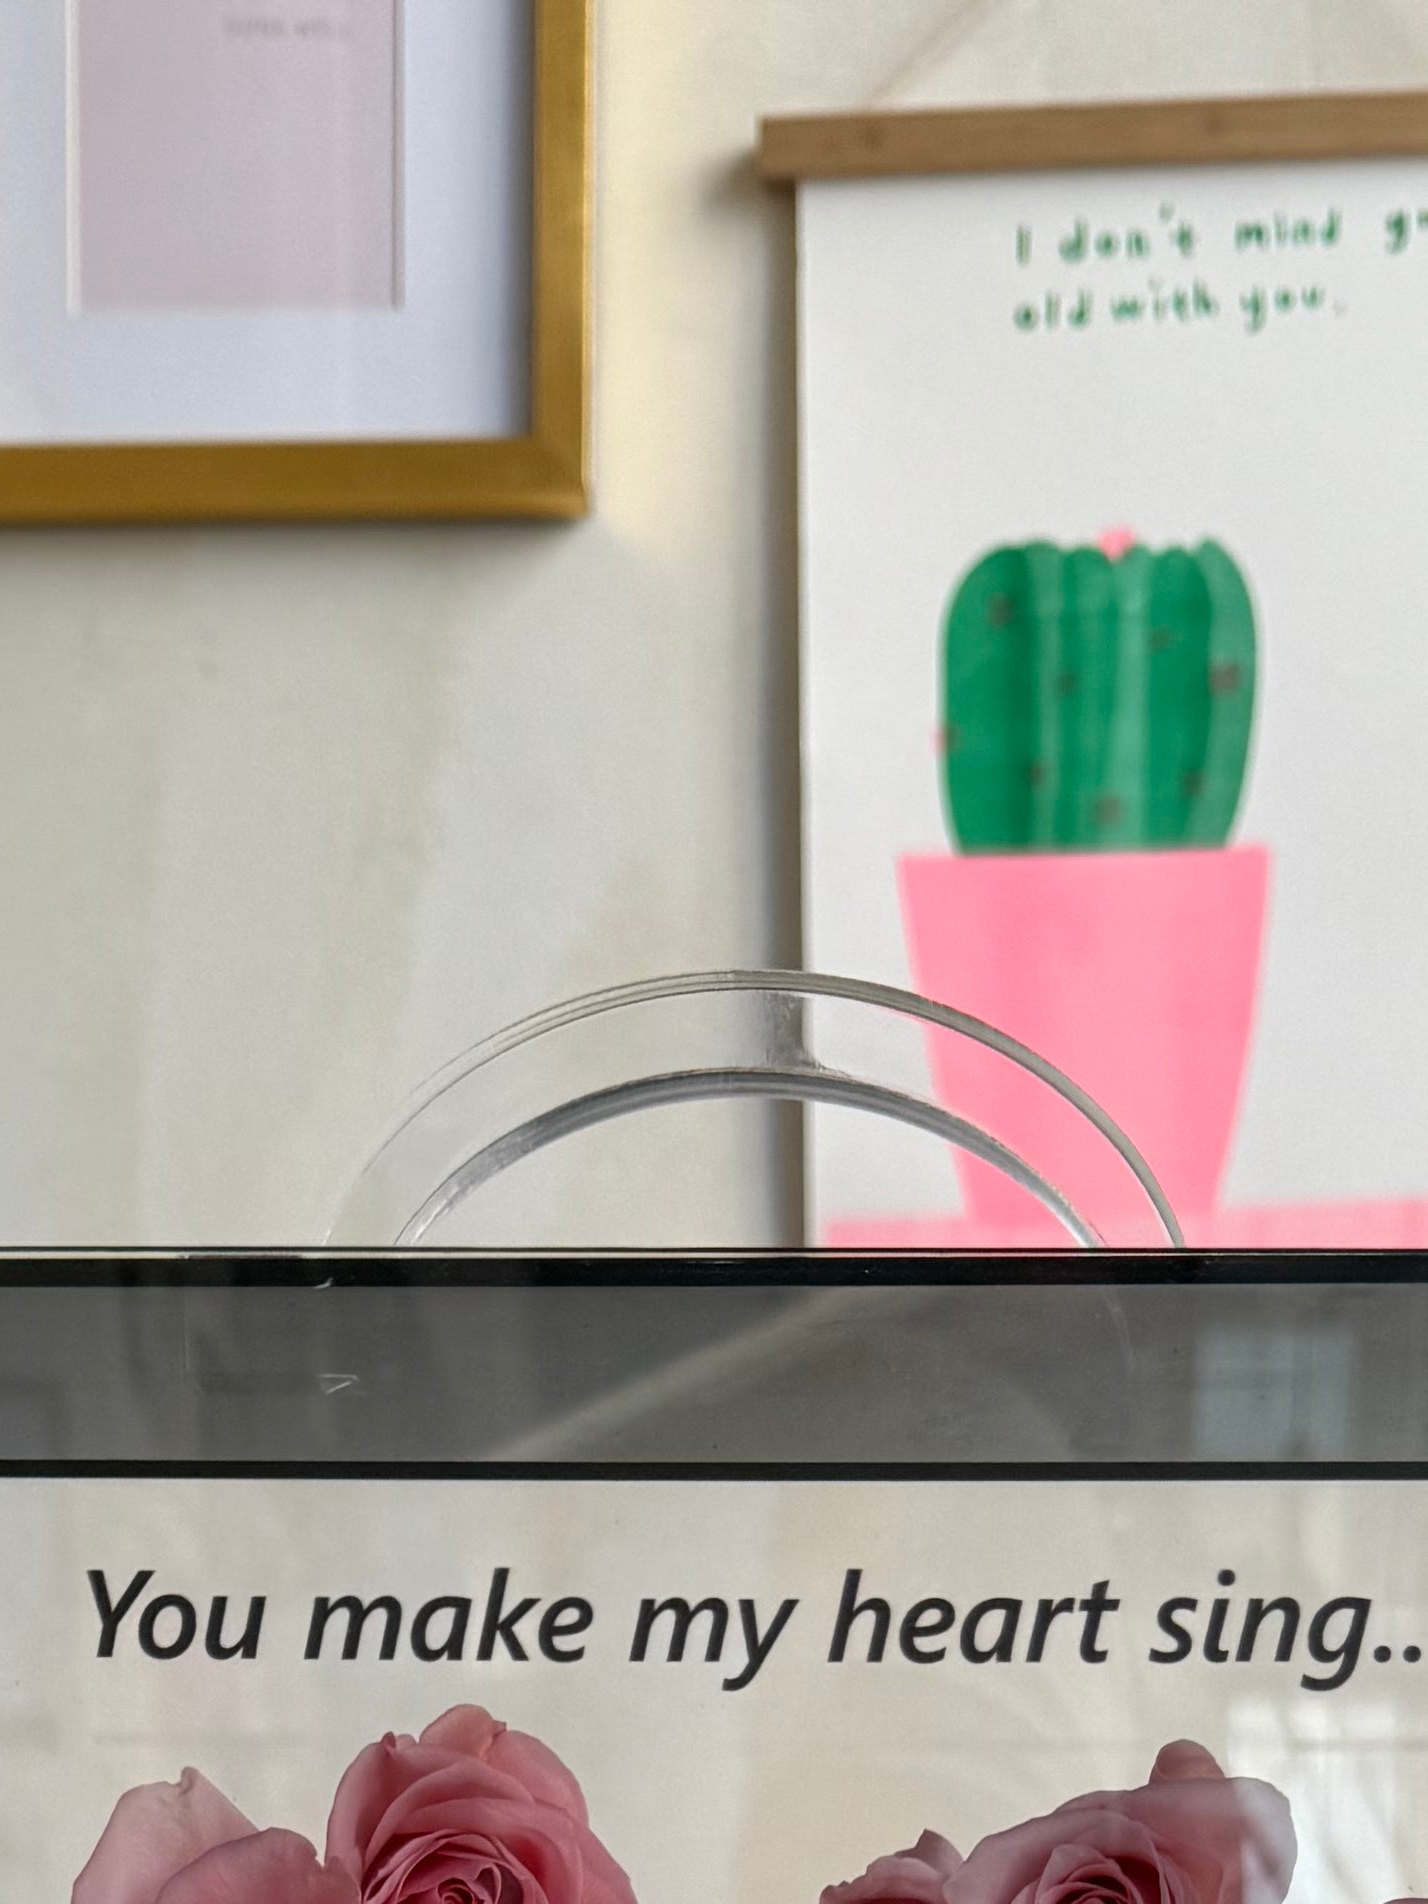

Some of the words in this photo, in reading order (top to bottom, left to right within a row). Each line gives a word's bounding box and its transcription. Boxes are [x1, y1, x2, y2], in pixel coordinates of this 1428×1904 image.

[1015, 222, 1032, 267] I
[1057, 200, 1197, 265] don't
[1233, 206, 1342, 252] mind
[1013, 288, 1093, 331] old
[1110, 275, 1219, 325] with
[85, 1570, 265, 1662] You
[302, 1568, 594, 1663] make
[628, 1594, 798, 1692] my
[826, 1570, 1120, 1665] heart
[1147, 1570, 1425, 1692] sing..
